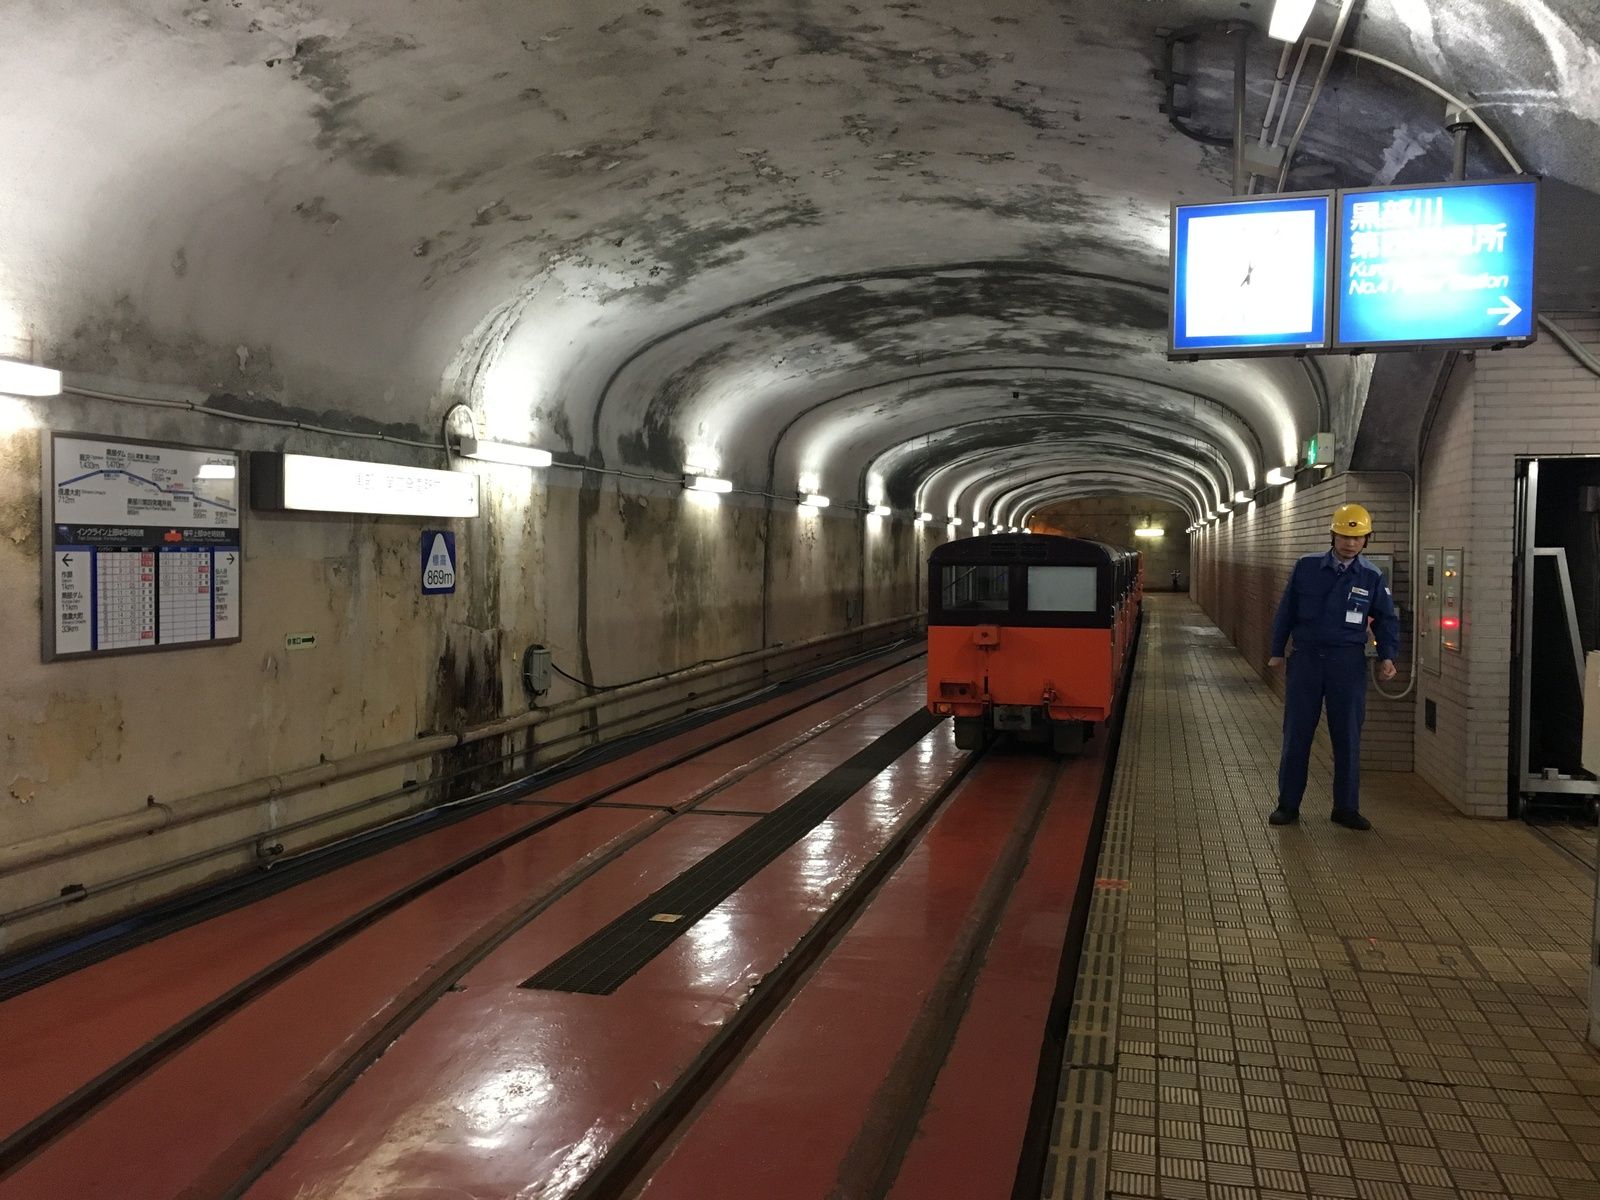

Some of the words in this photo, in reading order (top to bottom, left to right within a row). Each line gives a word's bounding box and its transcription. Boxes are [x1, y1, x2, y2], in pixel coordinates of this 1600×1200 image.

[1350, 196, 1443, 231] 黒部川
[427, 569, 453, 585] 869m
